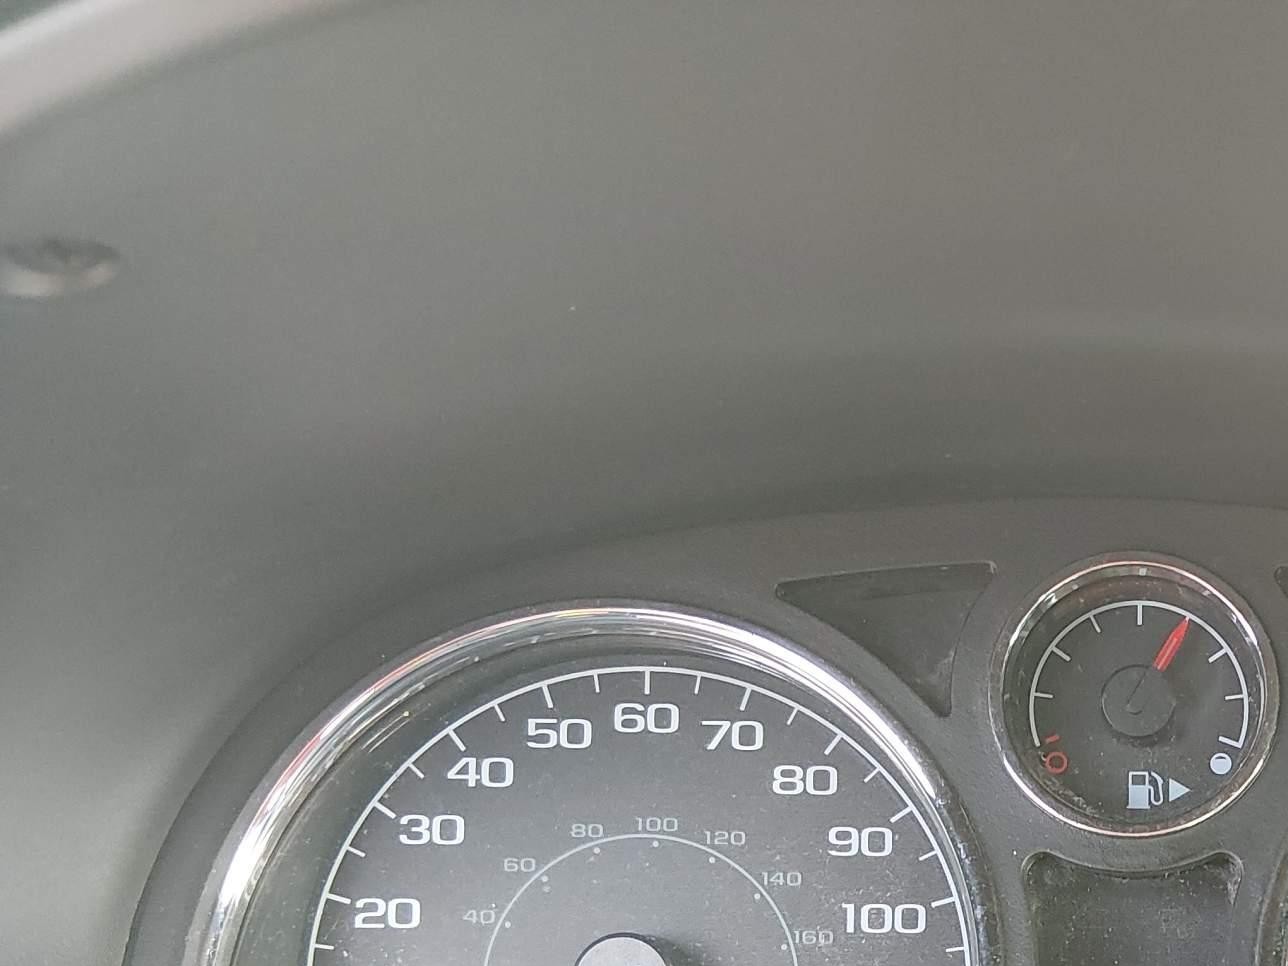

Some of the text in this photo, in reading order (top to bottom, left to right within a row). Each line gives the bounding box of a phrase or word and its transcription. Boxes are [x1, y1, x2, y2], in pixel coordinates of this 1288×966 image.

[613, 703, 680, 733] 60
[527, 719, 593, 749] 50
[701, 721, 764, 751] 70
[447, 757, 514, 787] 40
[772, 765, 838, 795] 80
[399, 815, 465, 845] 30
[570, 823, 603, 838] 80
[635, 817, 678, 831] 100
[703, 831, 746, 846] 120
[828, 827, 893, 856] 90
[503, 858, 536, 872] 60
[761, 872, 802, 886] 140
[354, 898, 421, 928] 20
[462, 910, 496, 924] 40
[842, 904, 926, 934] 100
[794, 931, 834, 945] 160
